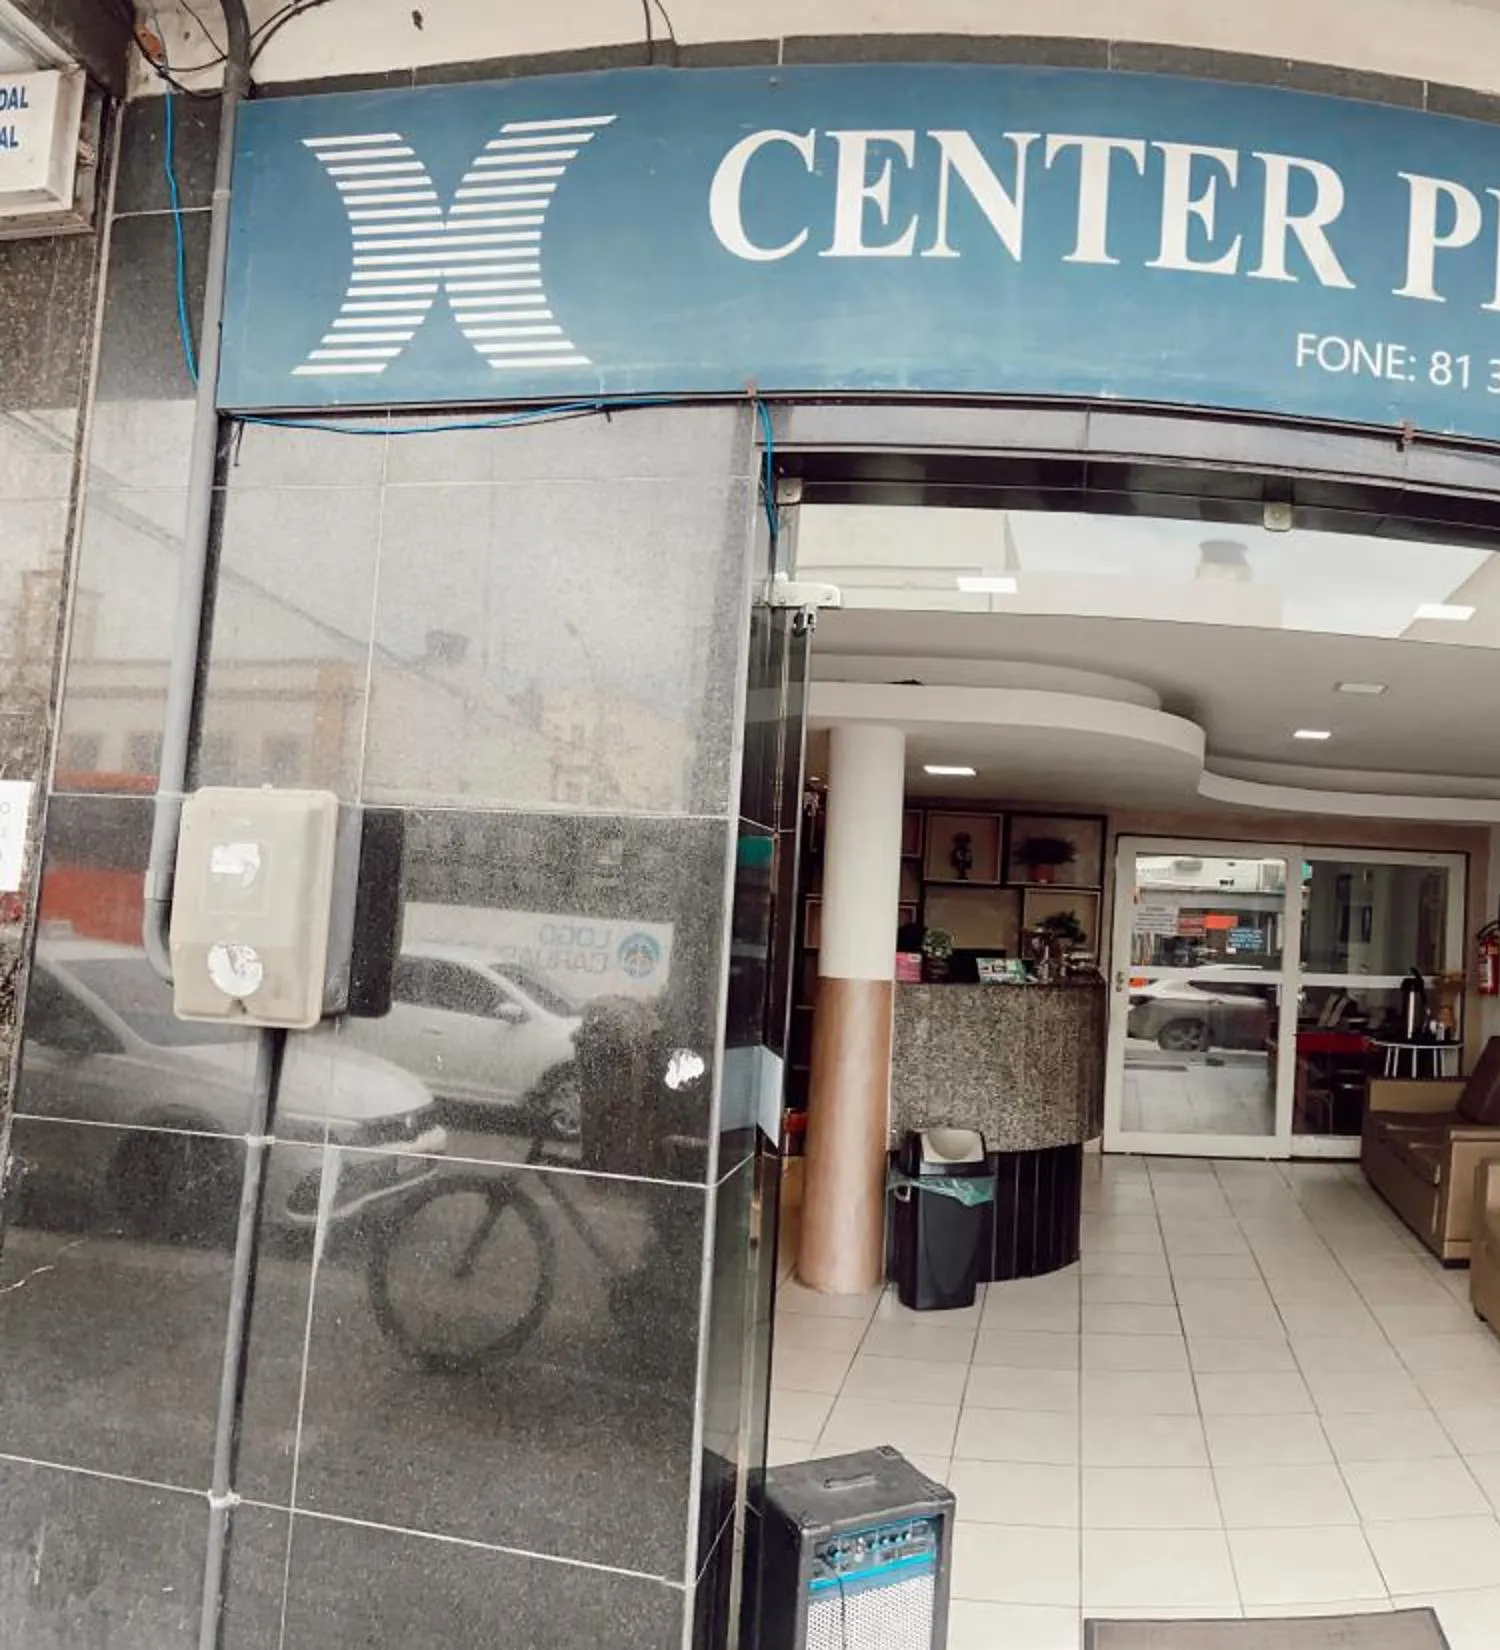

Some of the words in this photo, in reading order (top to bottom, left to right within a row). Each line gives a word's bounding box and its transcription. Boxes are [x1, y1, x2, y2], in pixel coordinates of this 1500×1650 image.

[709, 128, 1356, 289] CENTER
[1295, 332, 1416, 383] FONE:
[1428, 350, 1471, 390] 81
